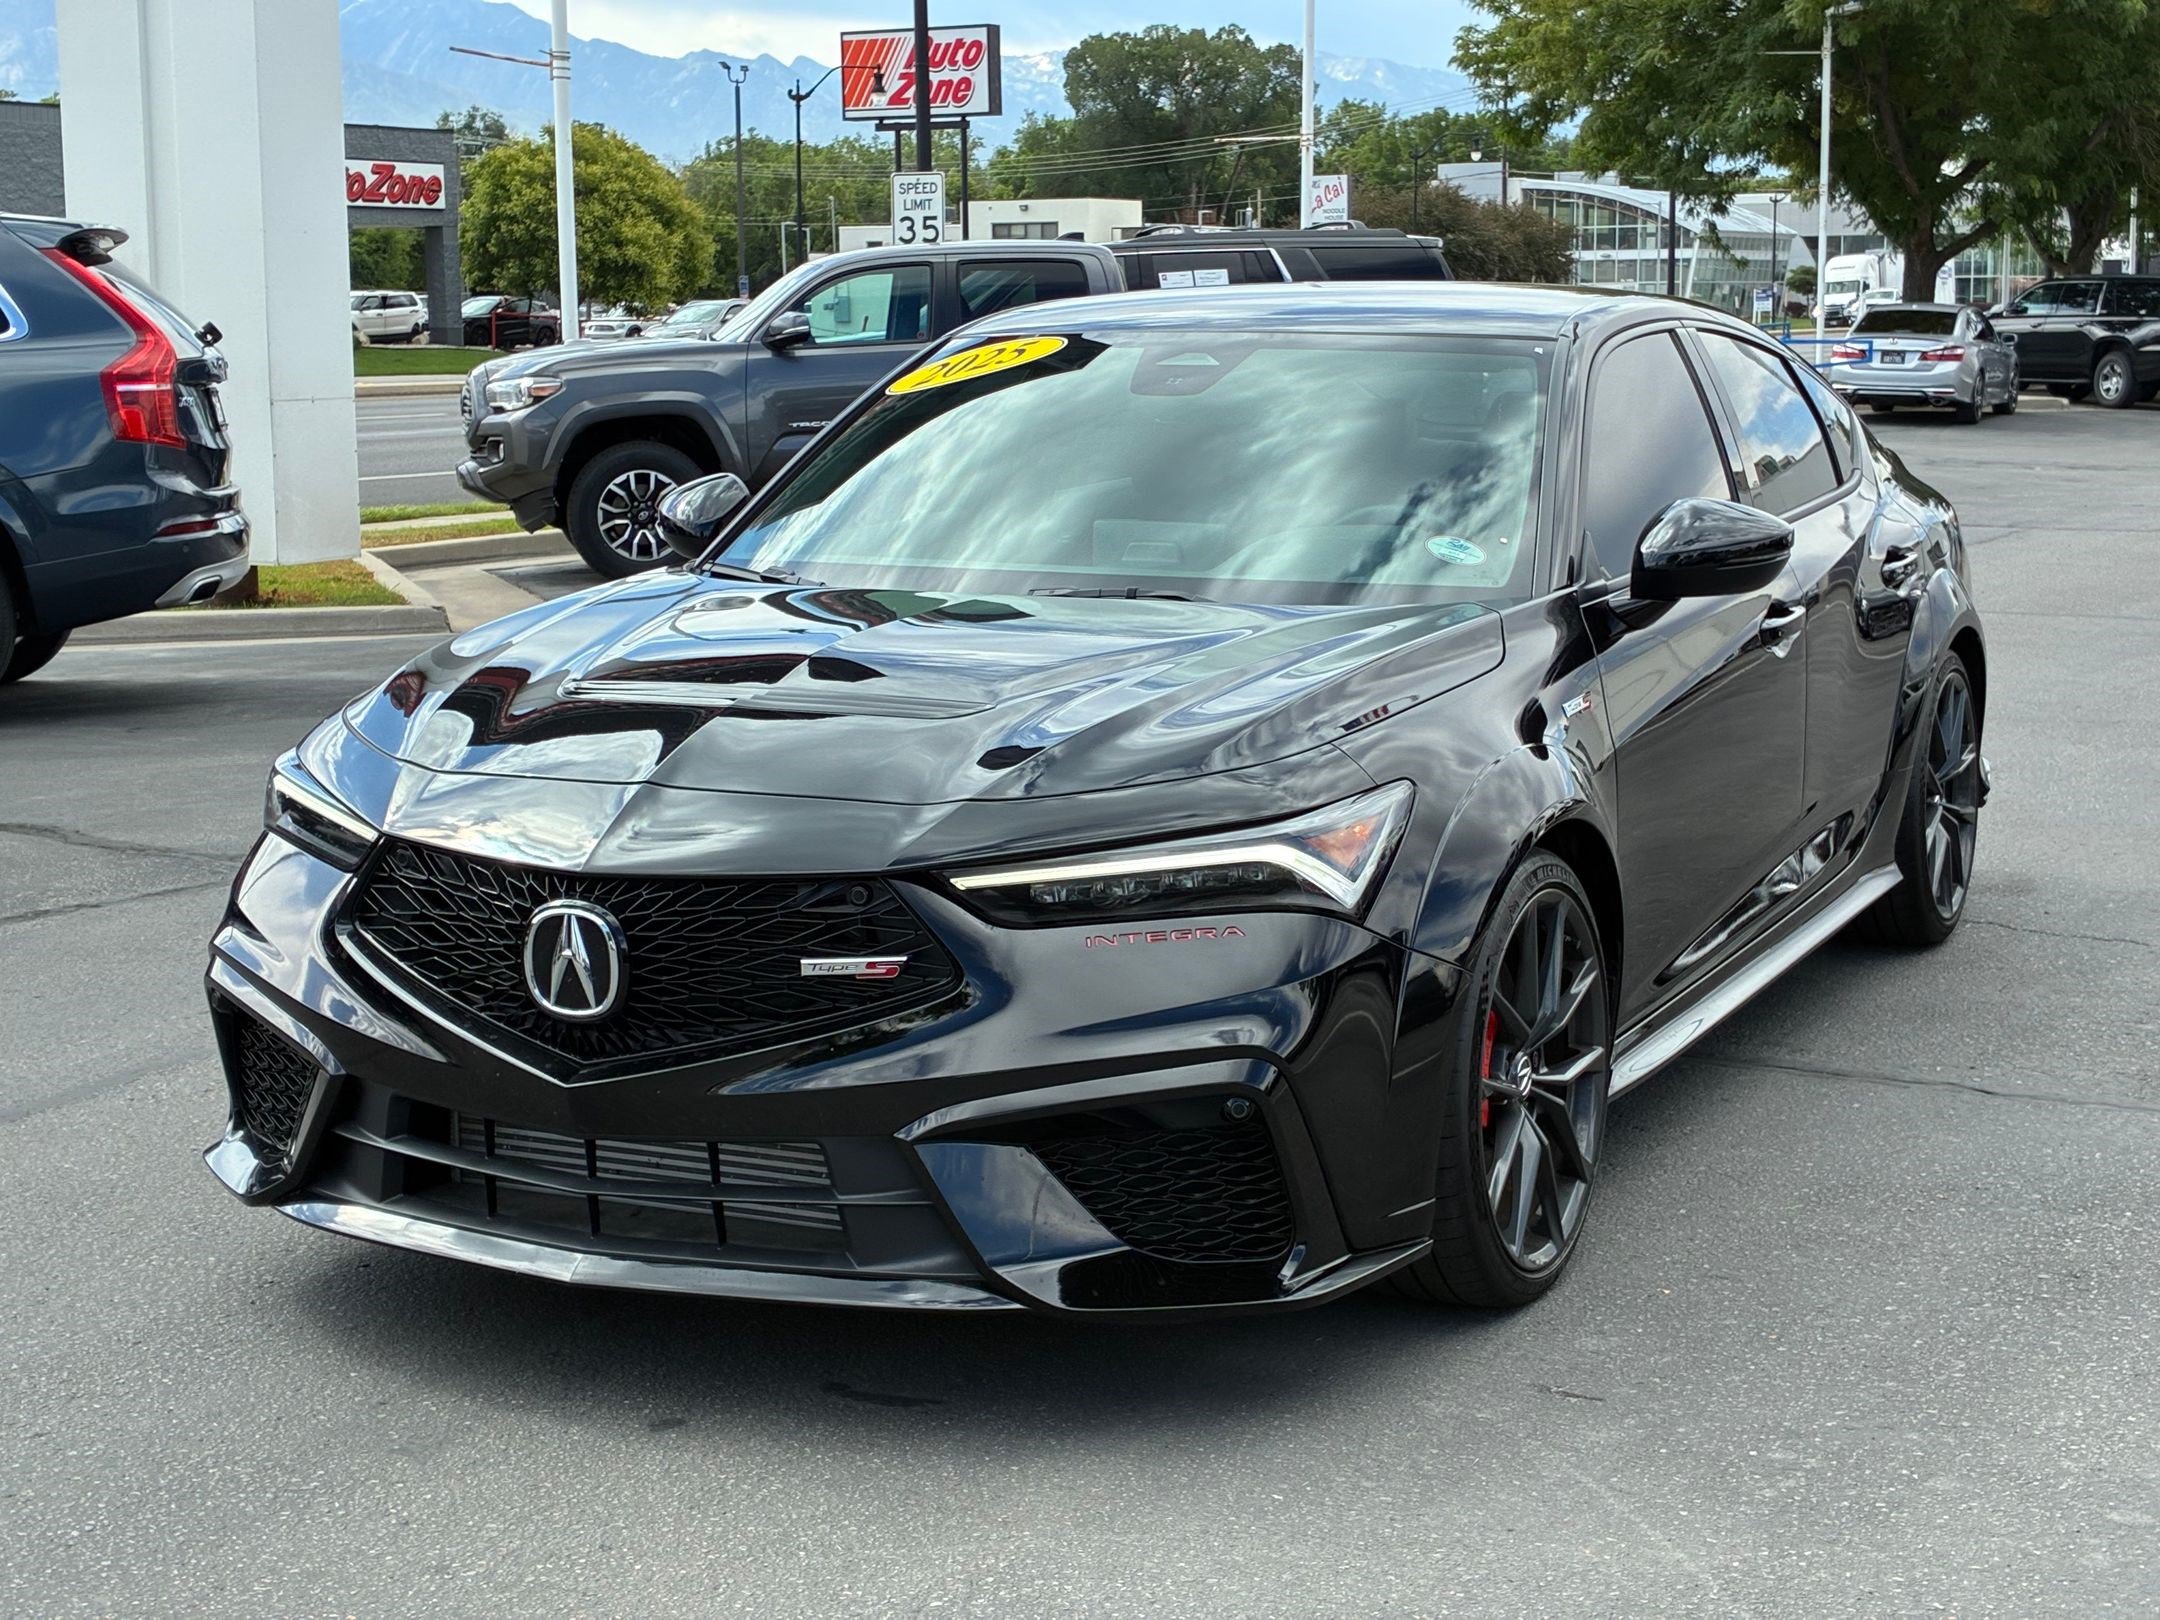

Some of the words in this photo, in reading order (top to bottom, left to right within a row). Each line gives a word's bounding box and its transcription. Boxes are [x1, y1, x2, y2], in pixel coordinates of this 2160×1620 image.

[886, 72, 972, 107] Zne
[345, 163, 441, 204] oZone
[899, 182, 938, 194] SPEED
[903, 198, 933, 211] LIMIT
[898, 215, 940, 244] 35
[911, 340, 1041, 388] 2025
[1086, 925, 1246, 948] INTEGRA
[808, 962, 858, 973] Type
[856, 961, 901, 979] S
